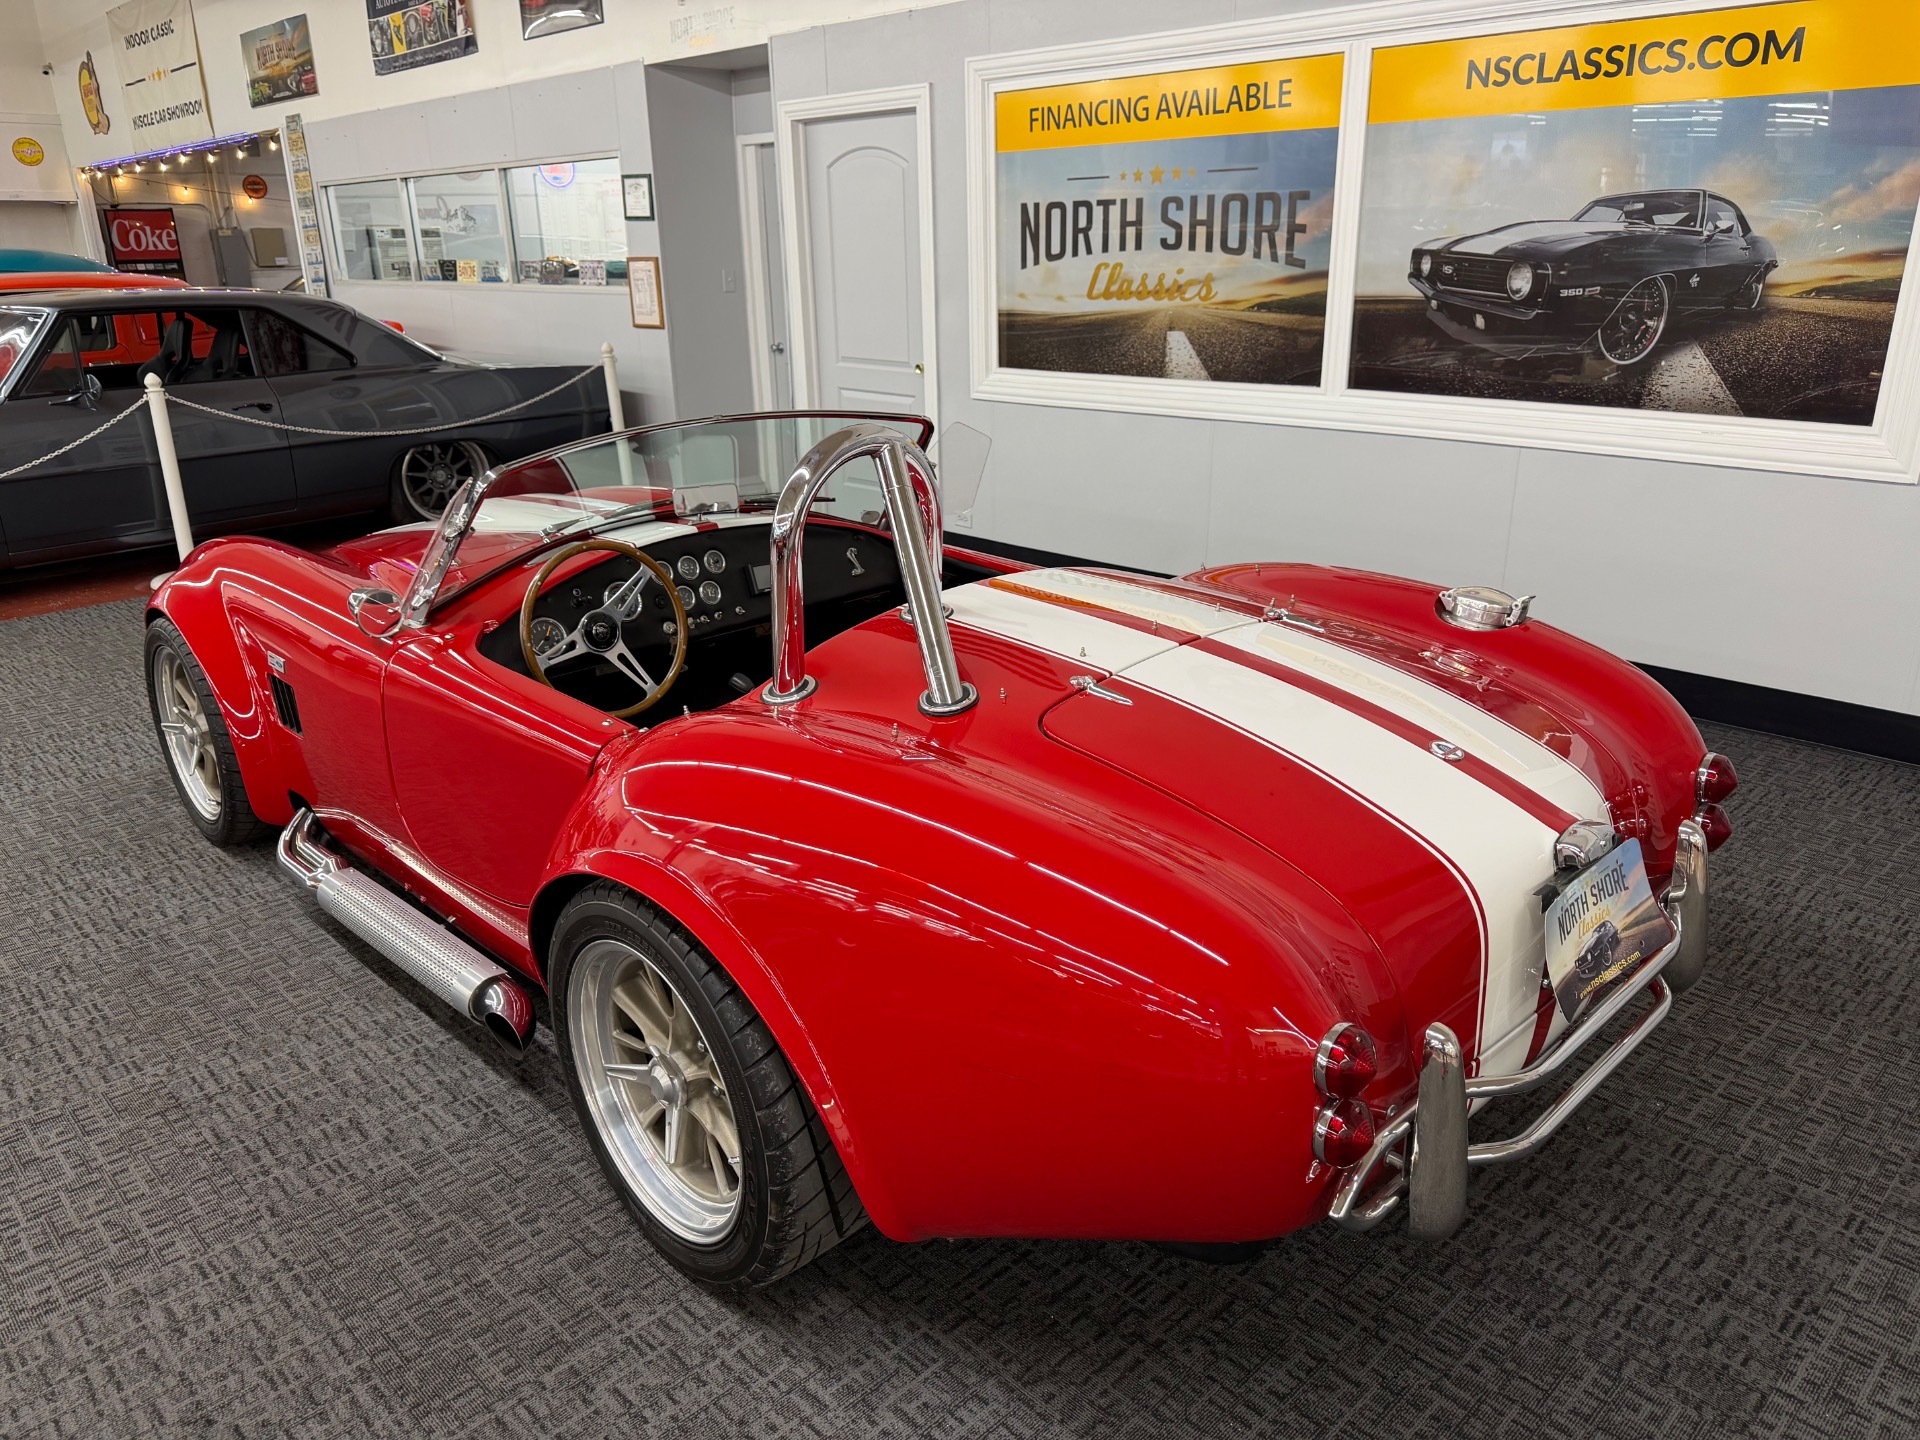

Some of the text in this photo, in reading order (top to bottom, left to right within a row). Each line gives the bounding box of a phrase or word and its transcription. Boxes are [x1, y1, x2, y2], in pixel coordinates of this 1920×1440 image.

[123, 18, 175, 51] INDOOR CLASSIC
[1466, 27, 1806, 90] NSCLASSICS.COM
[154, 108, 167, 125] CAR
[1029, 78, 1293, 133] FINANCING AVAILABLE
[111, 219, 179, 252] Coke
[1020, 190, 1311, 270] NORTH SHORE
[1086, 262, 1219, 302] Classics
[1559, 287, 1584, 297] 350
[1557, 862, 1630, 946] NORTH SHORE
[1578, 904, 1612, 940] Classics
[1579, 950, 1641, 1000] www.nsclassics.com
